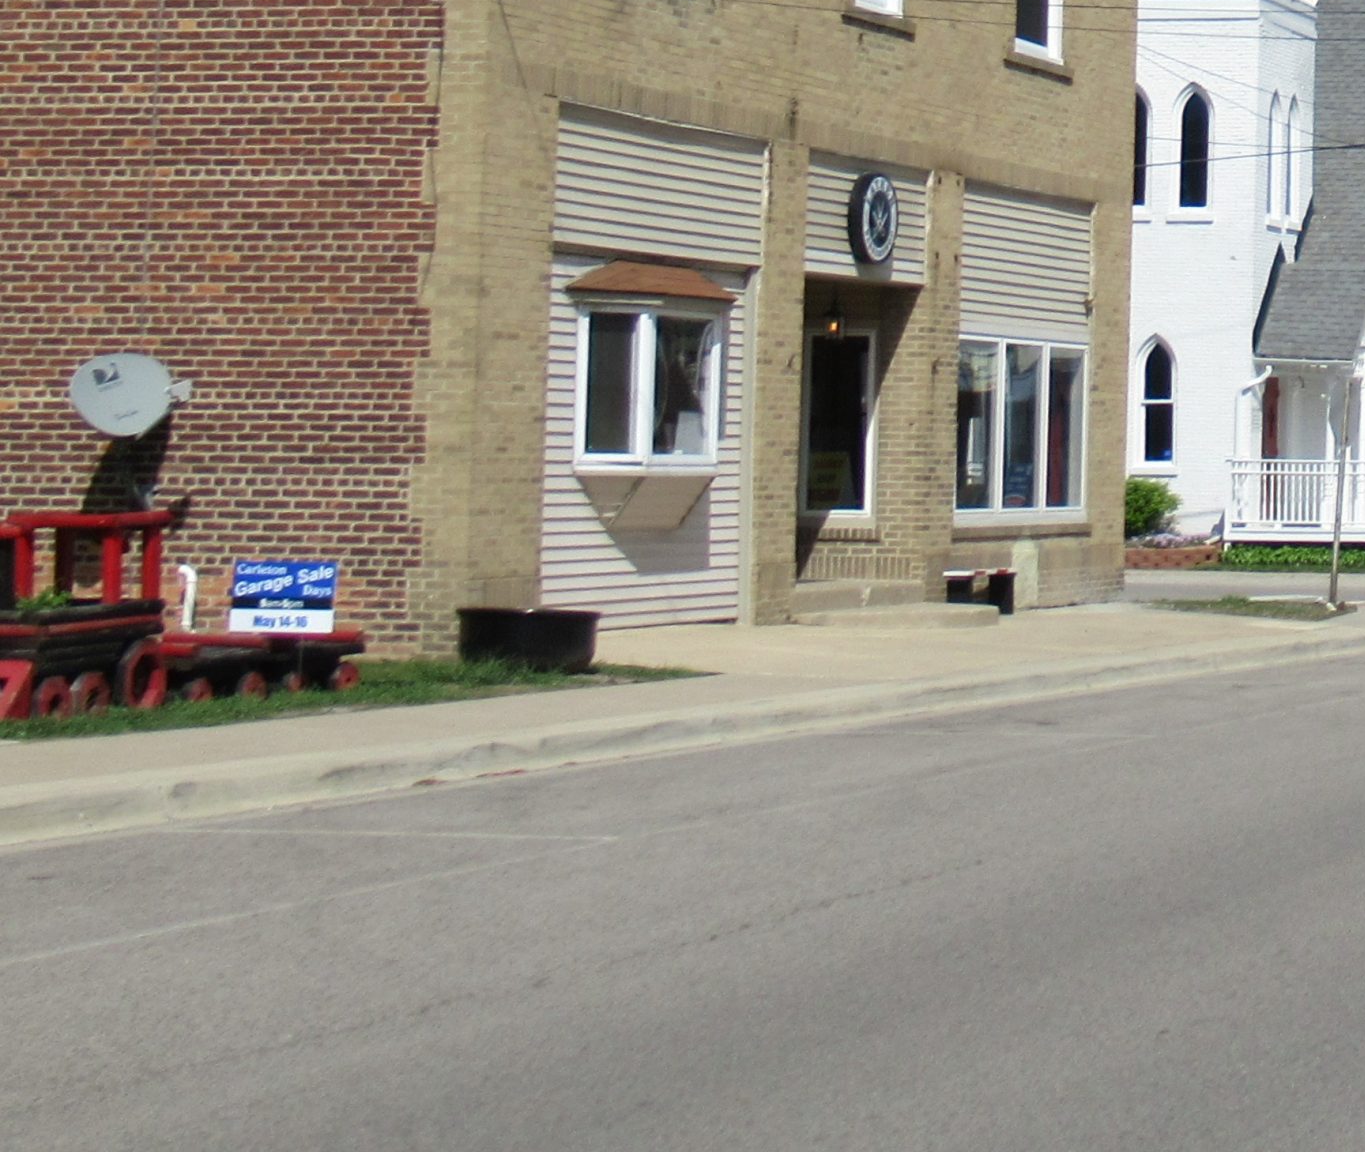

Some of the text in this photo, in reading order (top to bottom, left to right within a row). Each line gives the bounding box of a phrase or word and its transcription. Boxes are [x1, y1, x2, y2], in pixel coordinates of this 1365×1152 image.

[237, 563, 287, 575] Carleton
[234, 565, 334, 596] Garage Sale
[303, 584, 332, 597] Days
[253, 615, 276, 628] May
